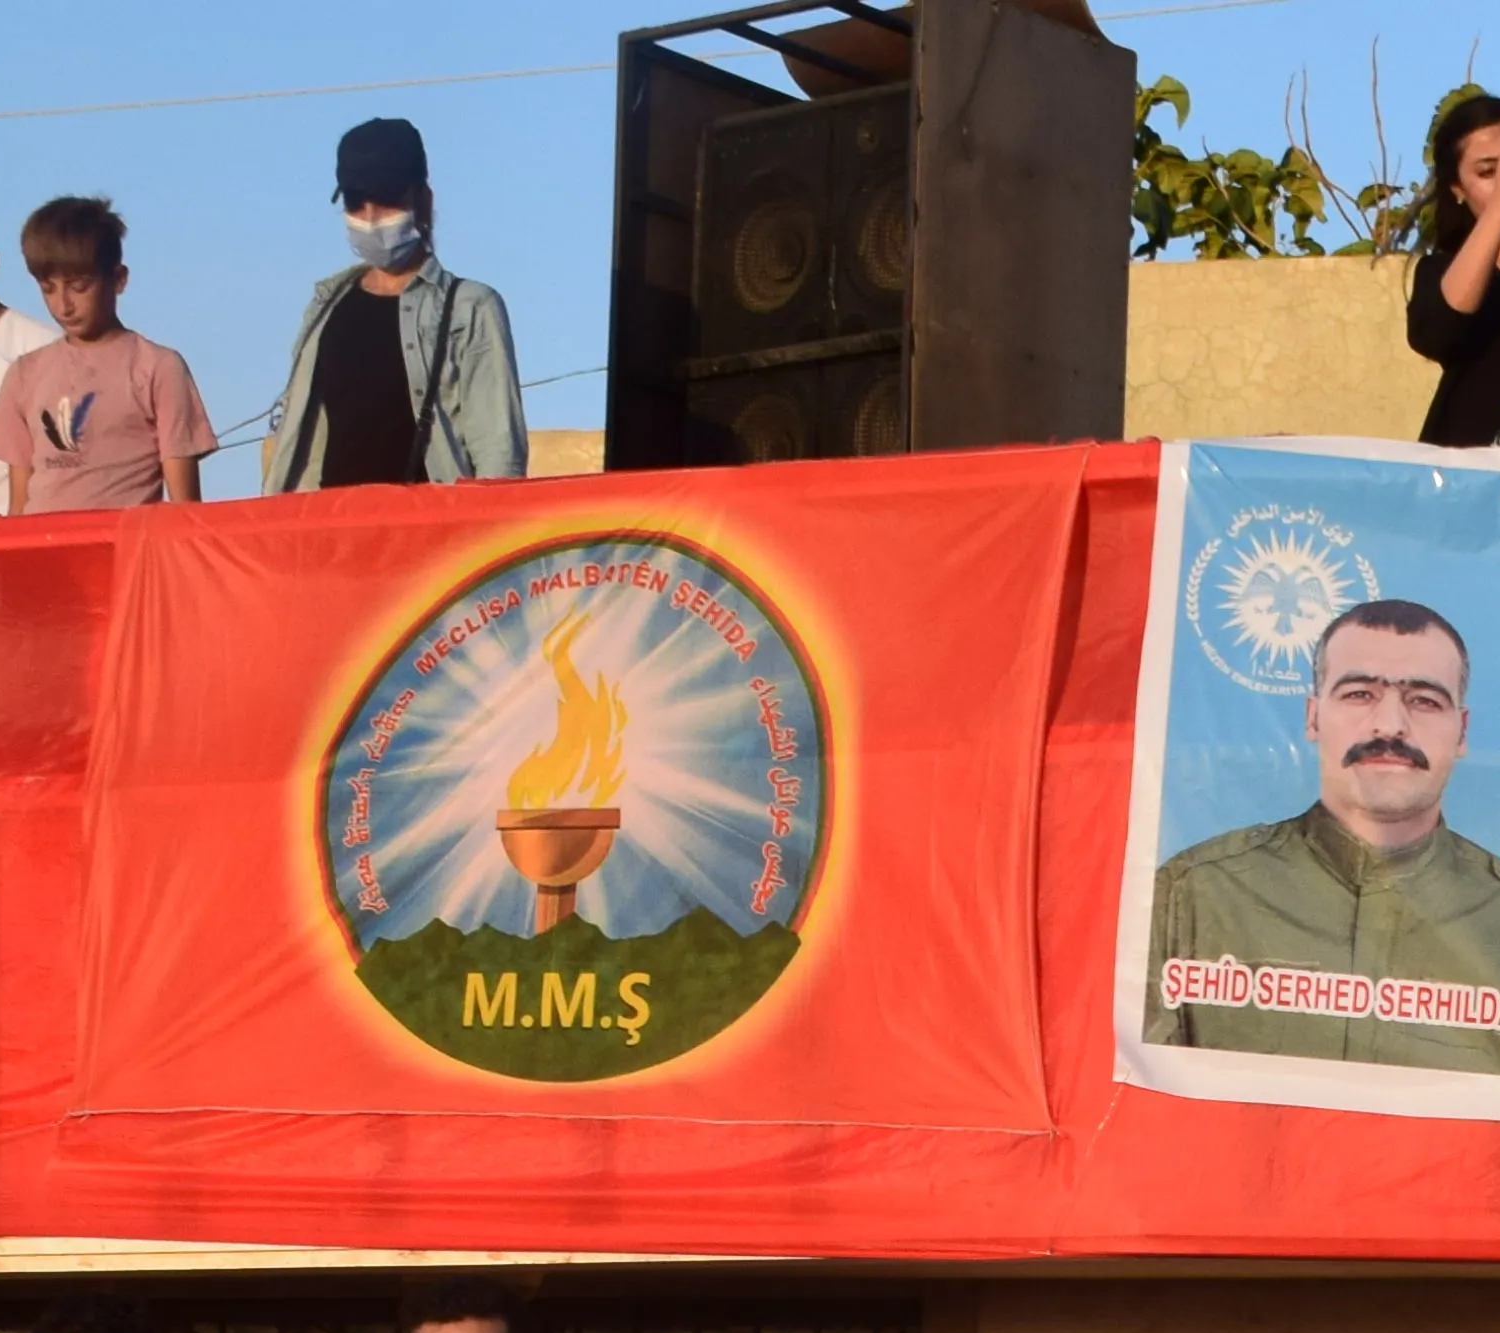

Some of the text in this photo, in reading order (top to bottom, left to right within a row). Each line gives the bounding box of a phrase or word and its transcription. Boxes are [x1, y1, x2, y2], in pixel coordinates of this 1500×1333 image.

[462, 972, 650, 1046] M.M.Ş
[1165, 961, 1249, 1005] ŞEHÎD
[1258, 972, 1370, 1014] SERHED
